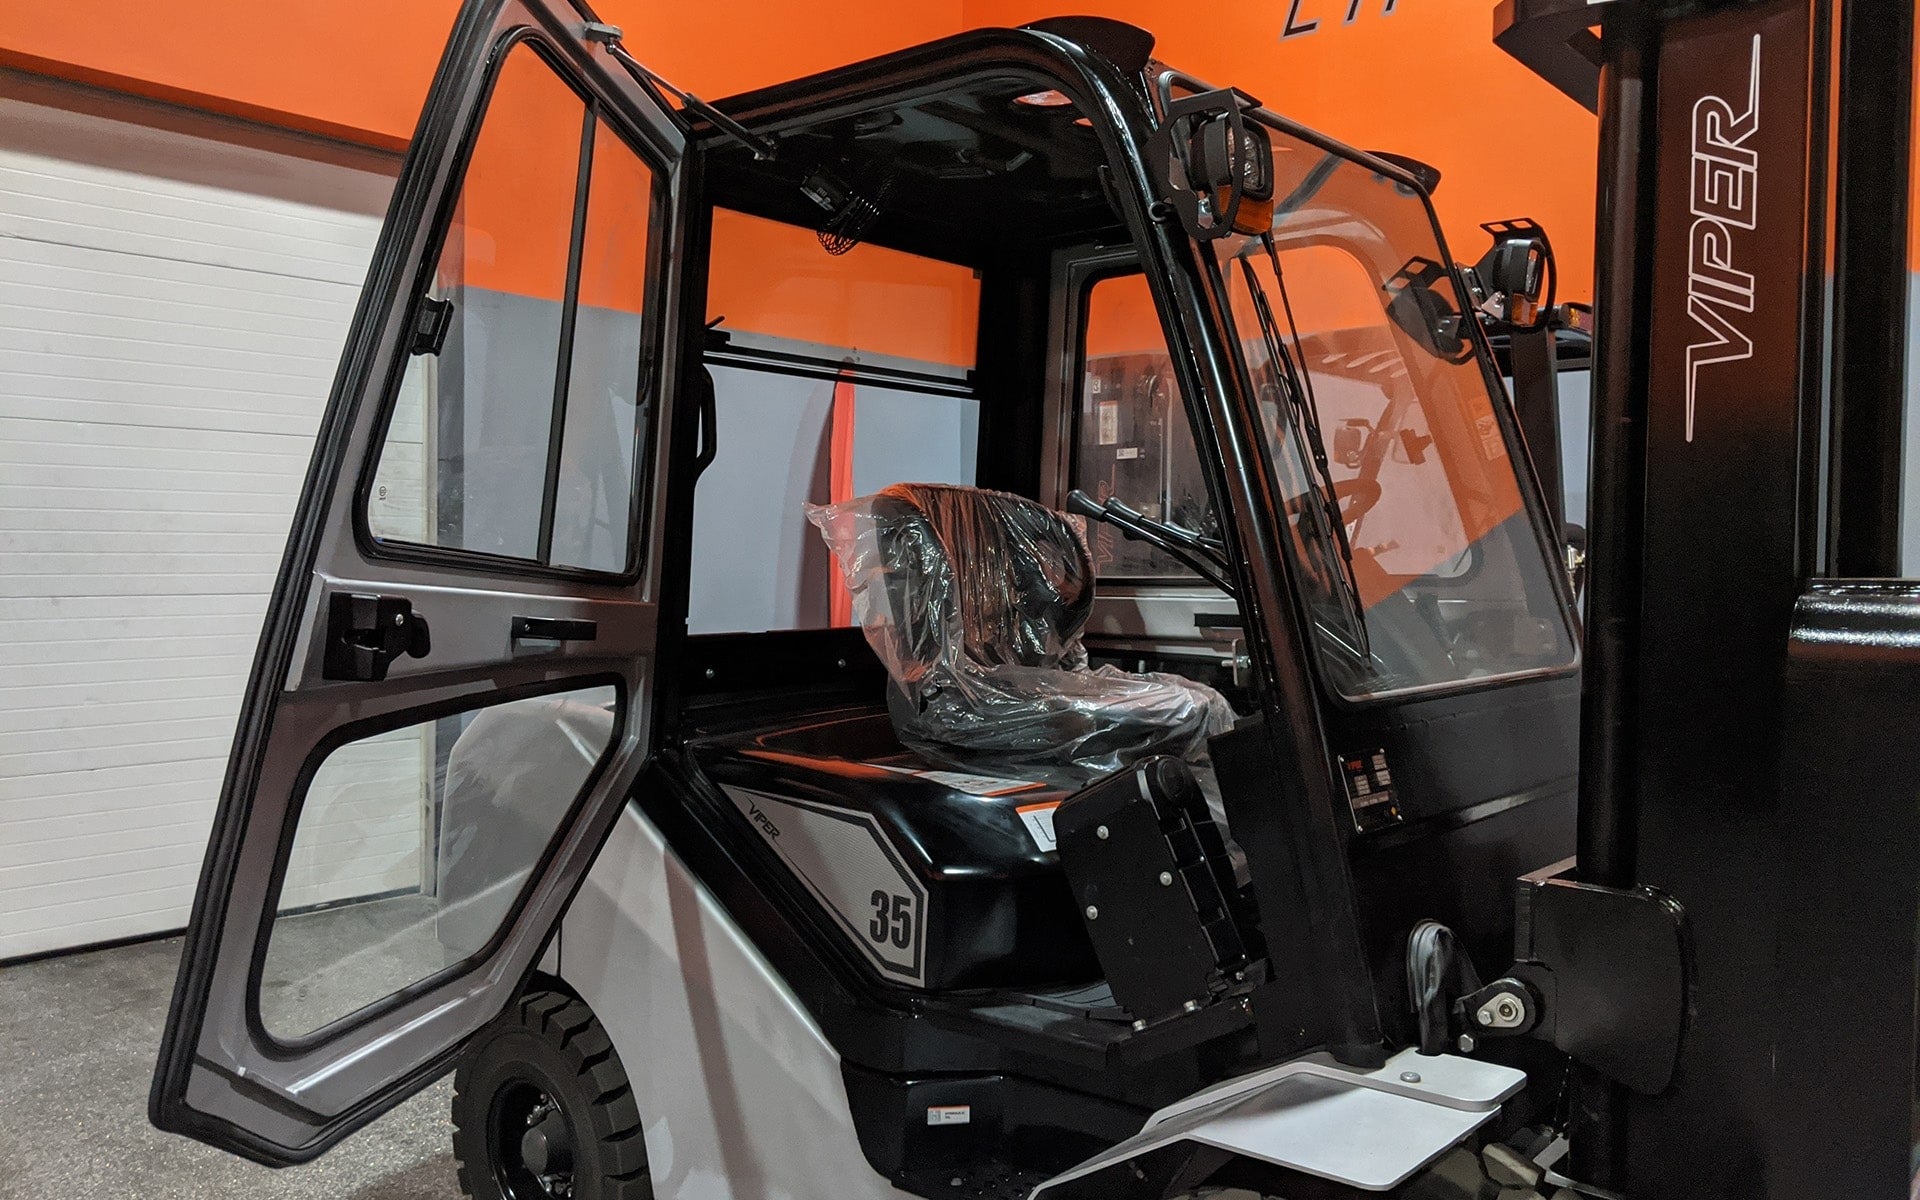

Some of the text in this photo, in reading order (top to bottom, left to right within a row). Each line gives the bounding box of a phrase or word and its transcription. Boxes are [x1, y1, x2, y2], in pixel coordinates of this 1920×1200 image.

[1686, 34, 1761, 443] VIPER
[1096, 463, 1116, 576] VIPR
[745, 796, 780, 846] VIPER
[869, 889, 912, 950] 35
